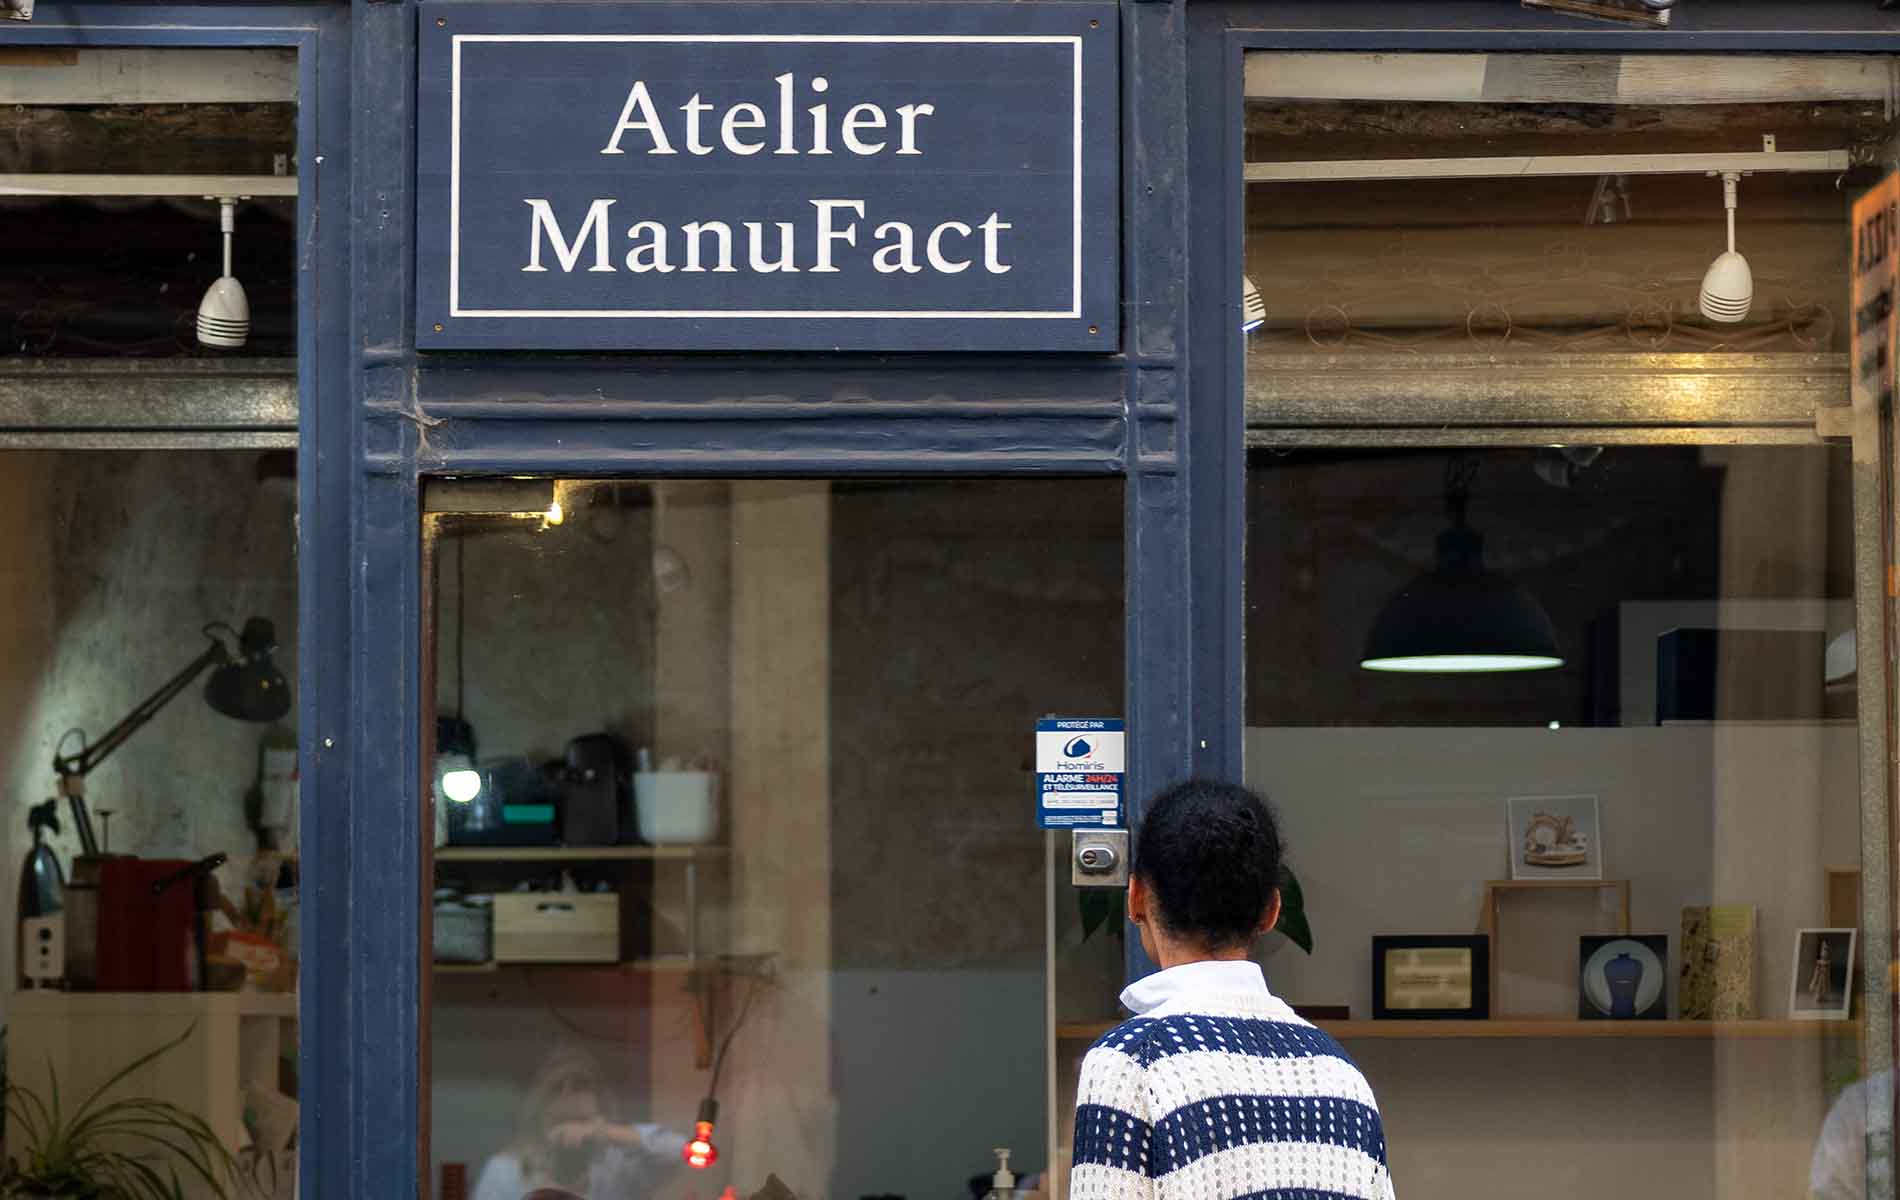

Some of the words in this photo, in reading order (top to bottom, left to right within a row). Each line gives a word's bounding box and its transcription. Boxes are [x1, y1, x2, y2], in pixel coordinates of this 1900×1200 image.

[600, 71, 934, 155] Atelier
[521, 198, 1012, 274] ManuFact
[1089, 721, 1104, 729] PAR
[1057, 761, 1105, 771] Homiris
[1043, 774, 1084, 783] ALARME
